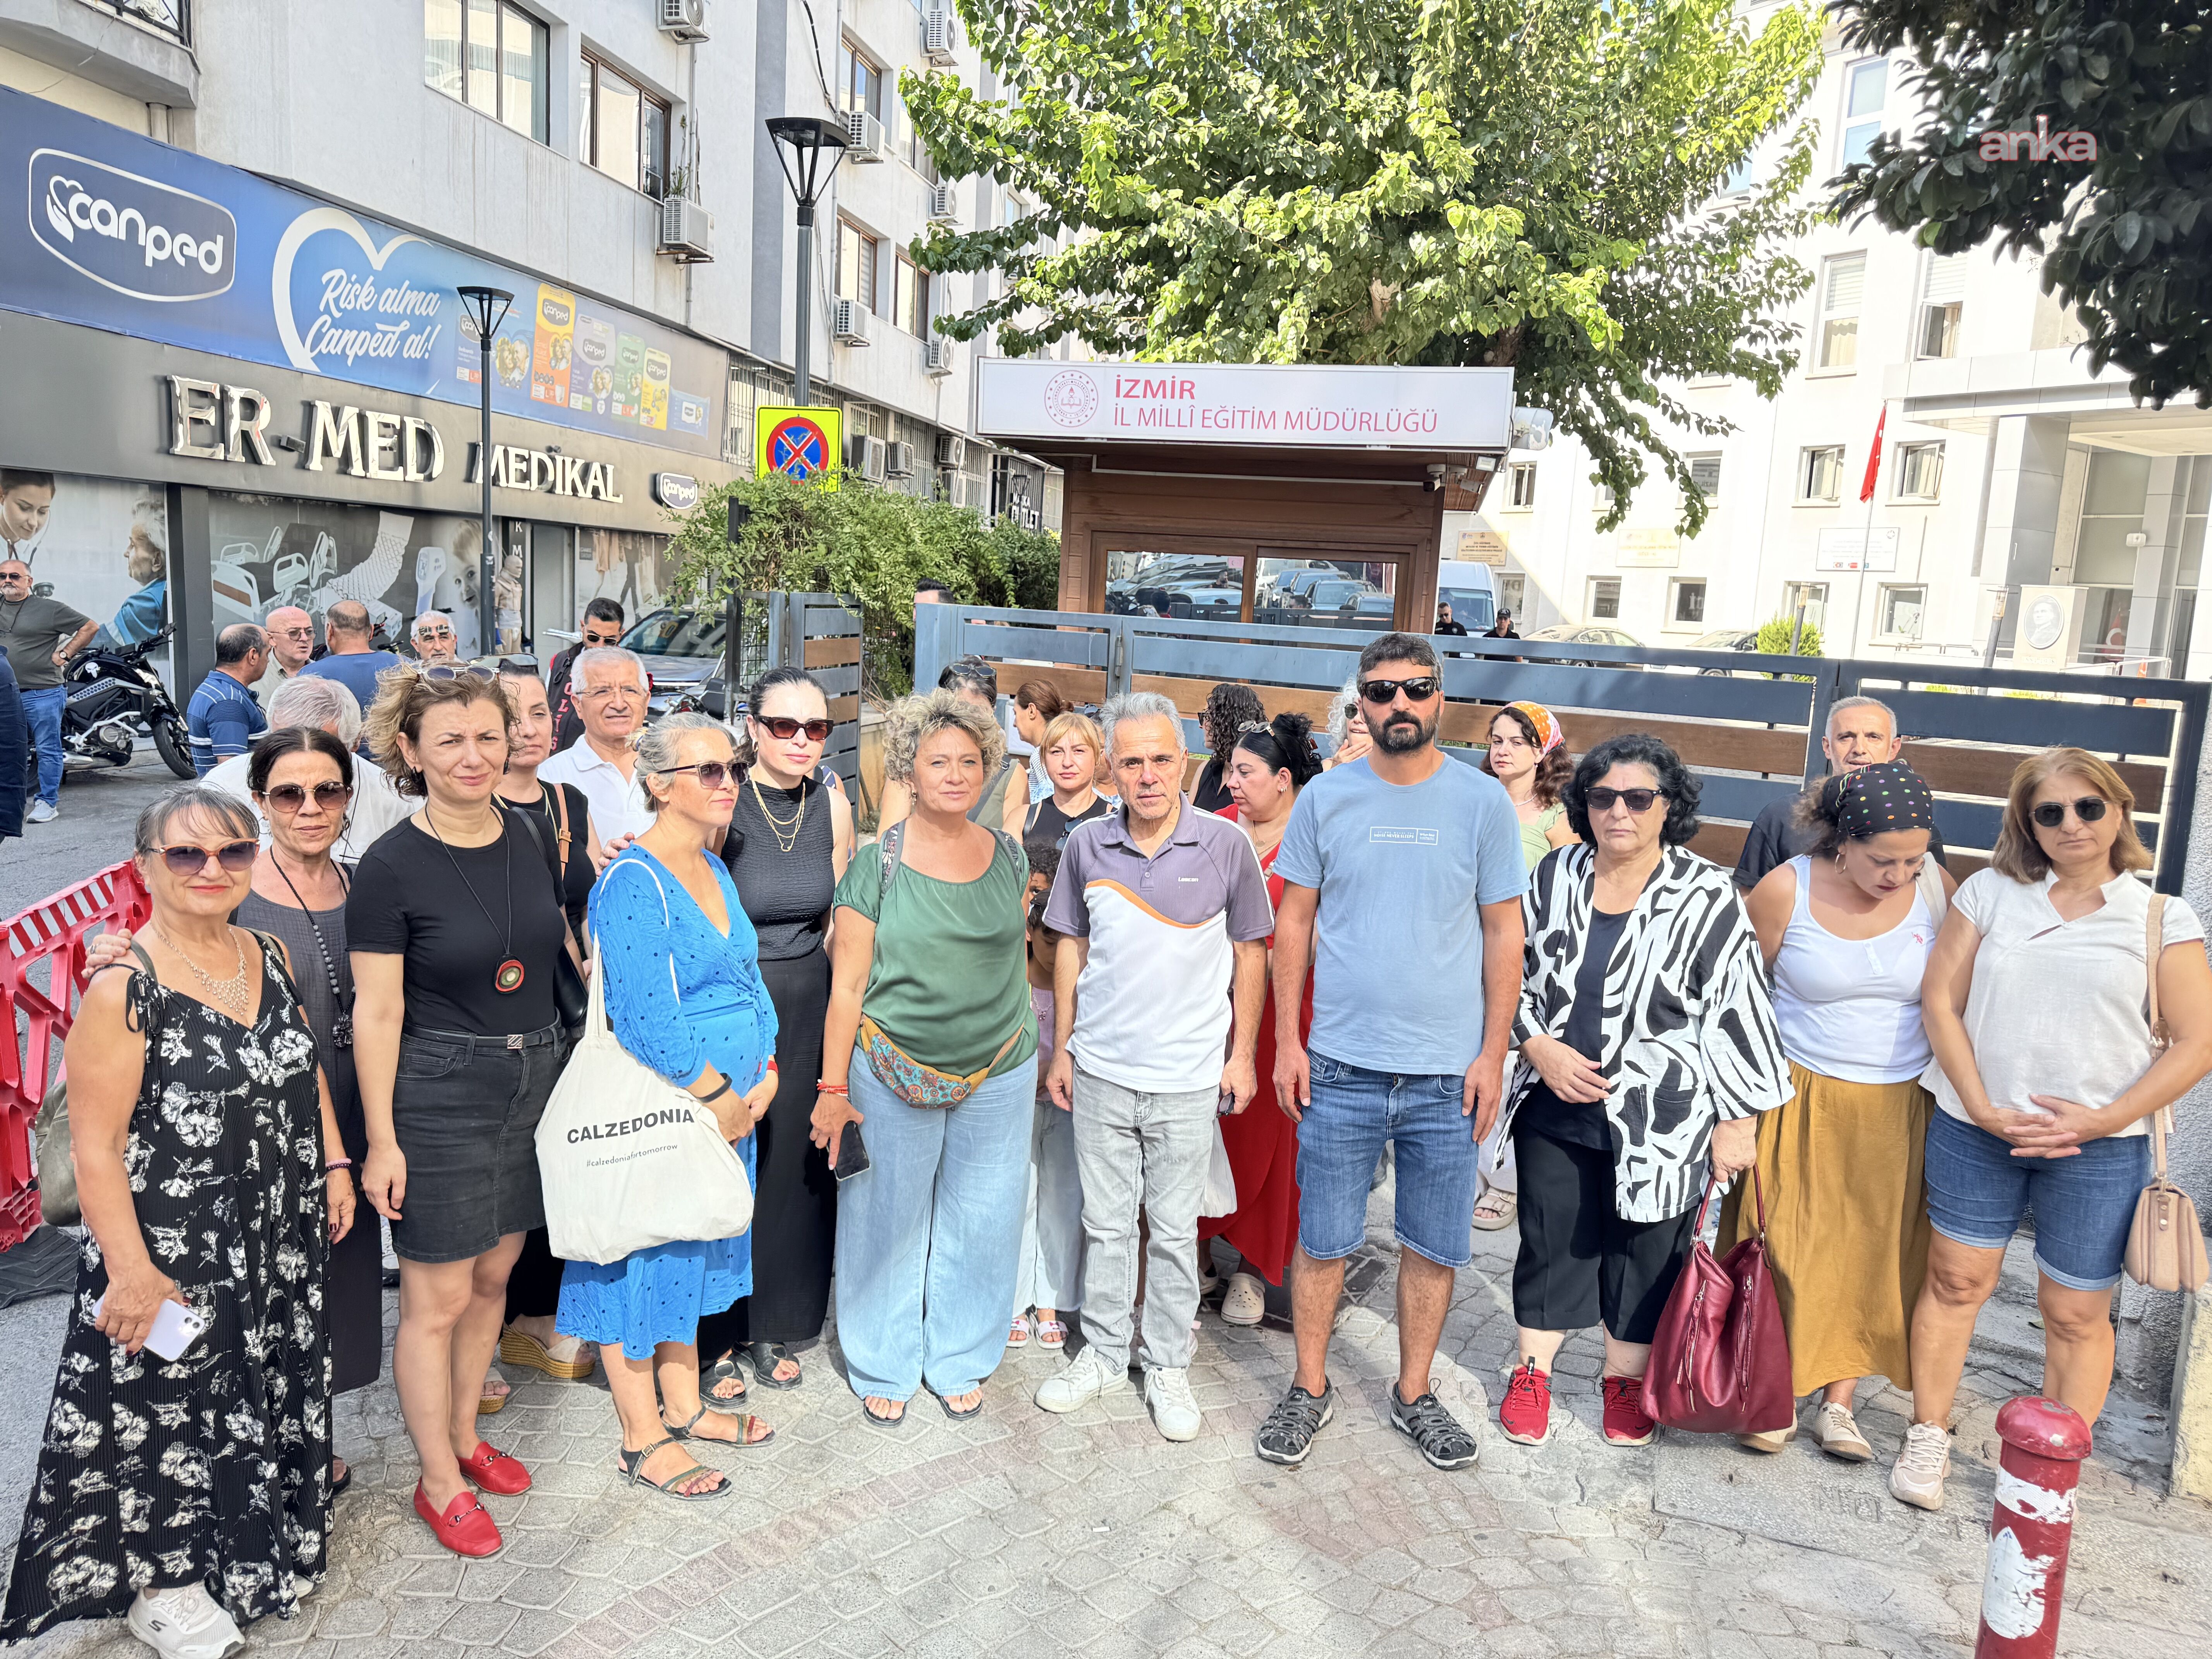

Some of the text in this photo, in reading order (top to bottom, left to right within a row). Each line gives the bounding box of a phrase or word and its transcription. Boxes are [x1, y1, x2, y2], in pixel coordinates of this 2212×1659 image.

[69, 192, 224, 275] canped
[319, 268, 441, 318] Risk alma
[304, 314, 442, 367] Canped al!
[1115, 374, 1195, 400] İZMİR
[169, 374, 445, 483] ER-MED
[1114, 403, 1131, 426] İL
[1201, 405, 1276, 430] EĞİTİM
[1284, 407, 1437, 433] MÜDÜRLÜĞÜ
[567, 1109, 695, 1144] CALZEDONIA
